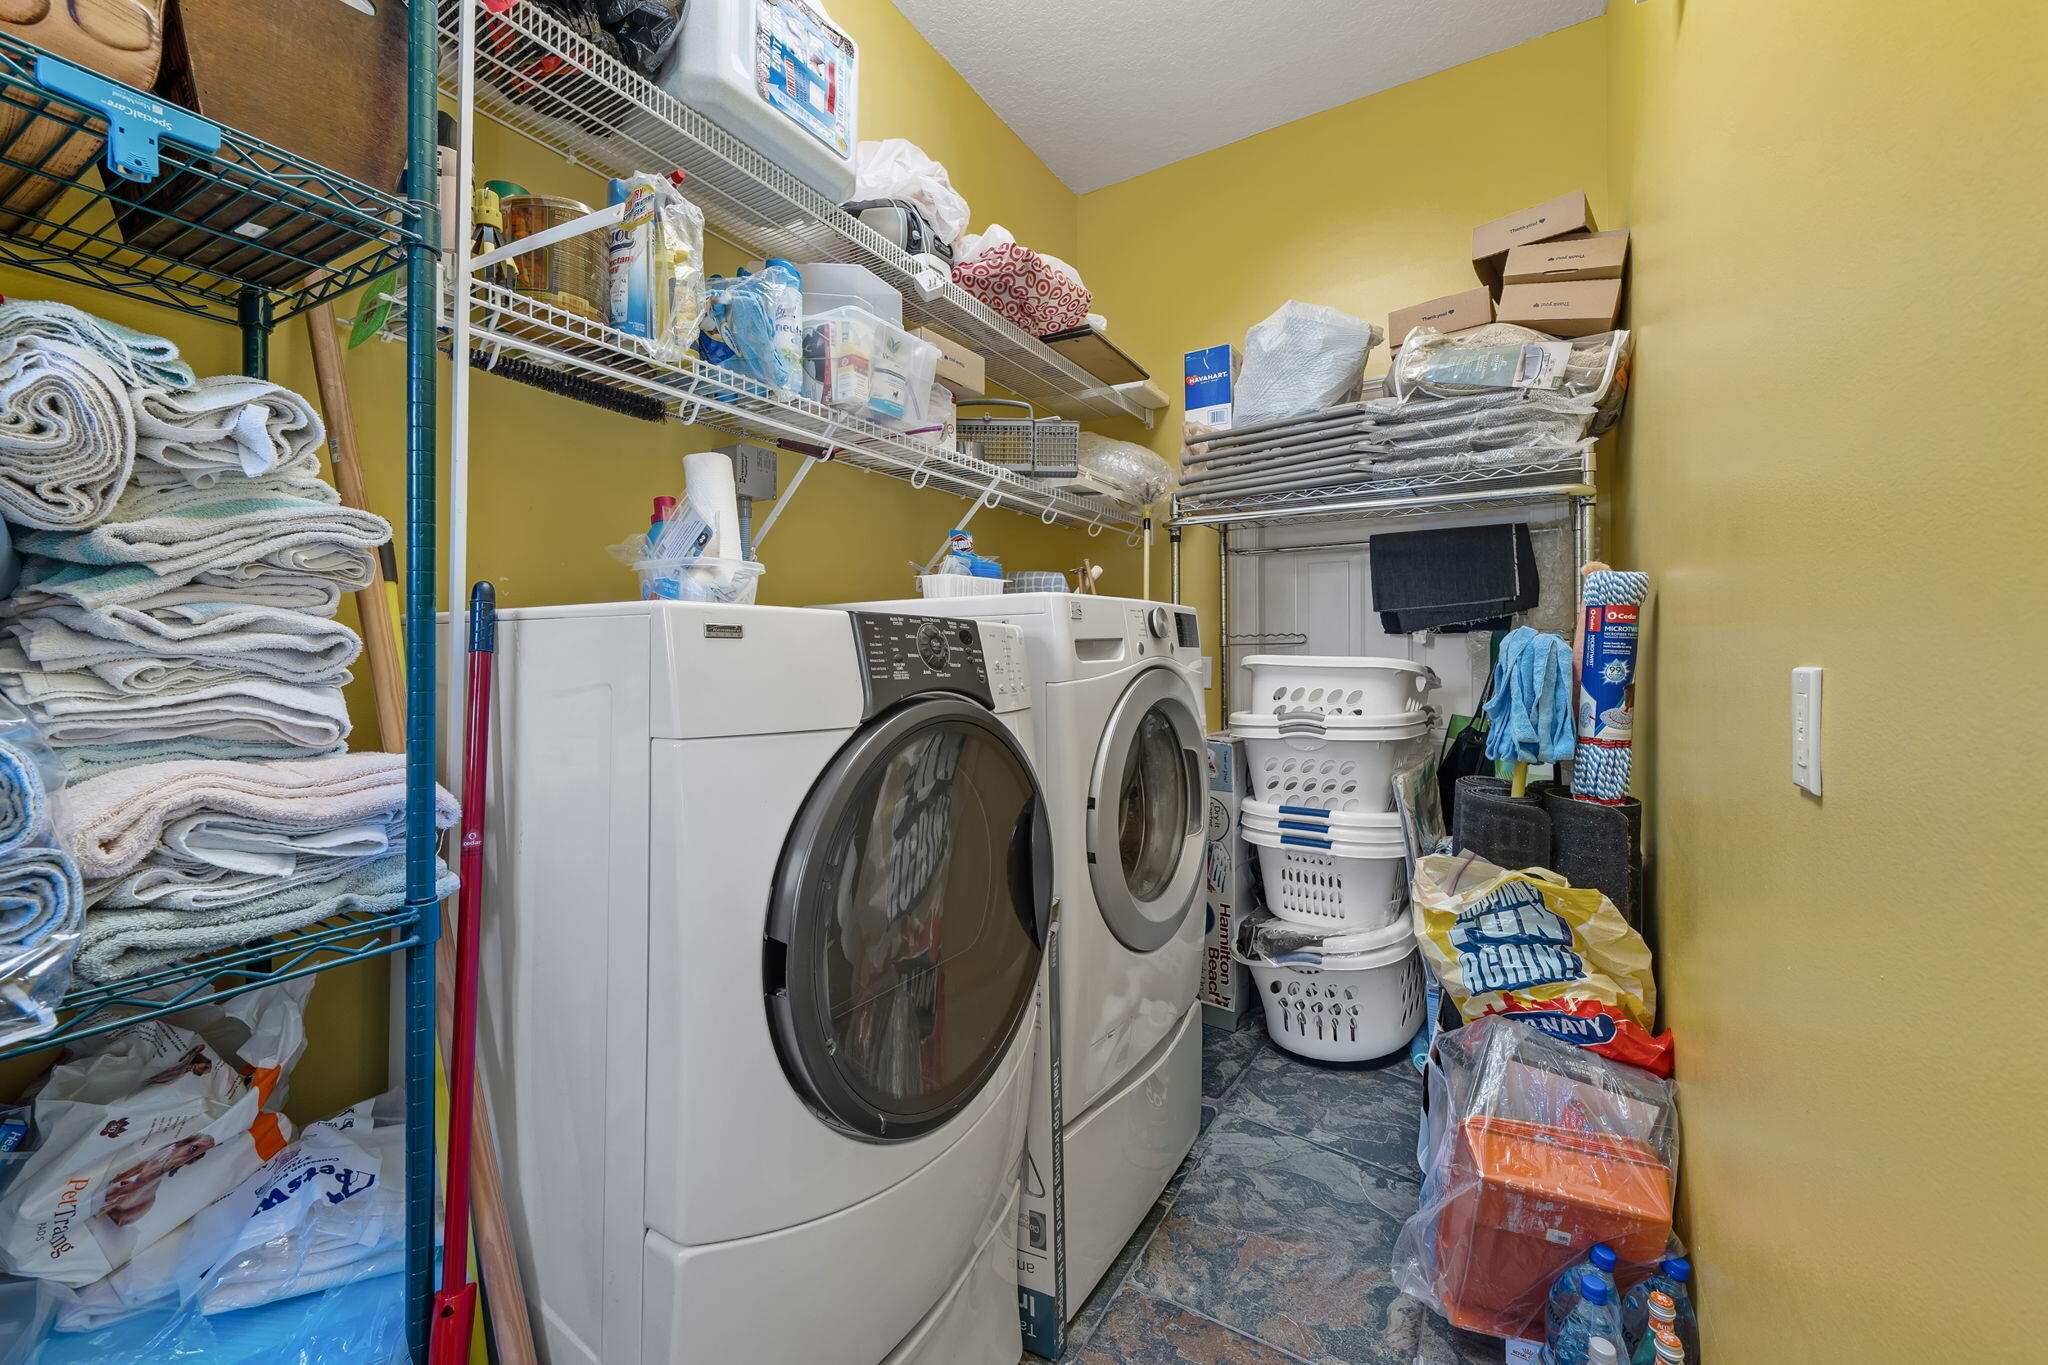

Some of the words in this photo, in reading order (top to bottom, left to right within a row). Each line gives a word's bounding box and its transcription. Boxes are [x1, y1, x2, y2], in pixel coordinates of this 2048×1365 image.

[104, 101, 173, 131] SpecialCare
[1189, 371, 1226, 384] HAVAHART
[1609, 666, 1621, 674] 99
[1220, 903, 1231, 985] Hamilton
[1460, 943, 1575, 994] AGAIN!
[1540, 1015, 1604, 1038] NAVY
[1053, 1056, 1061, 1099] Table
[1053, 1099, 1062, 1130] Top
[1054, 1130, 1062, 1186] Ironing
[1056, 1232, 1065, 1260] and
